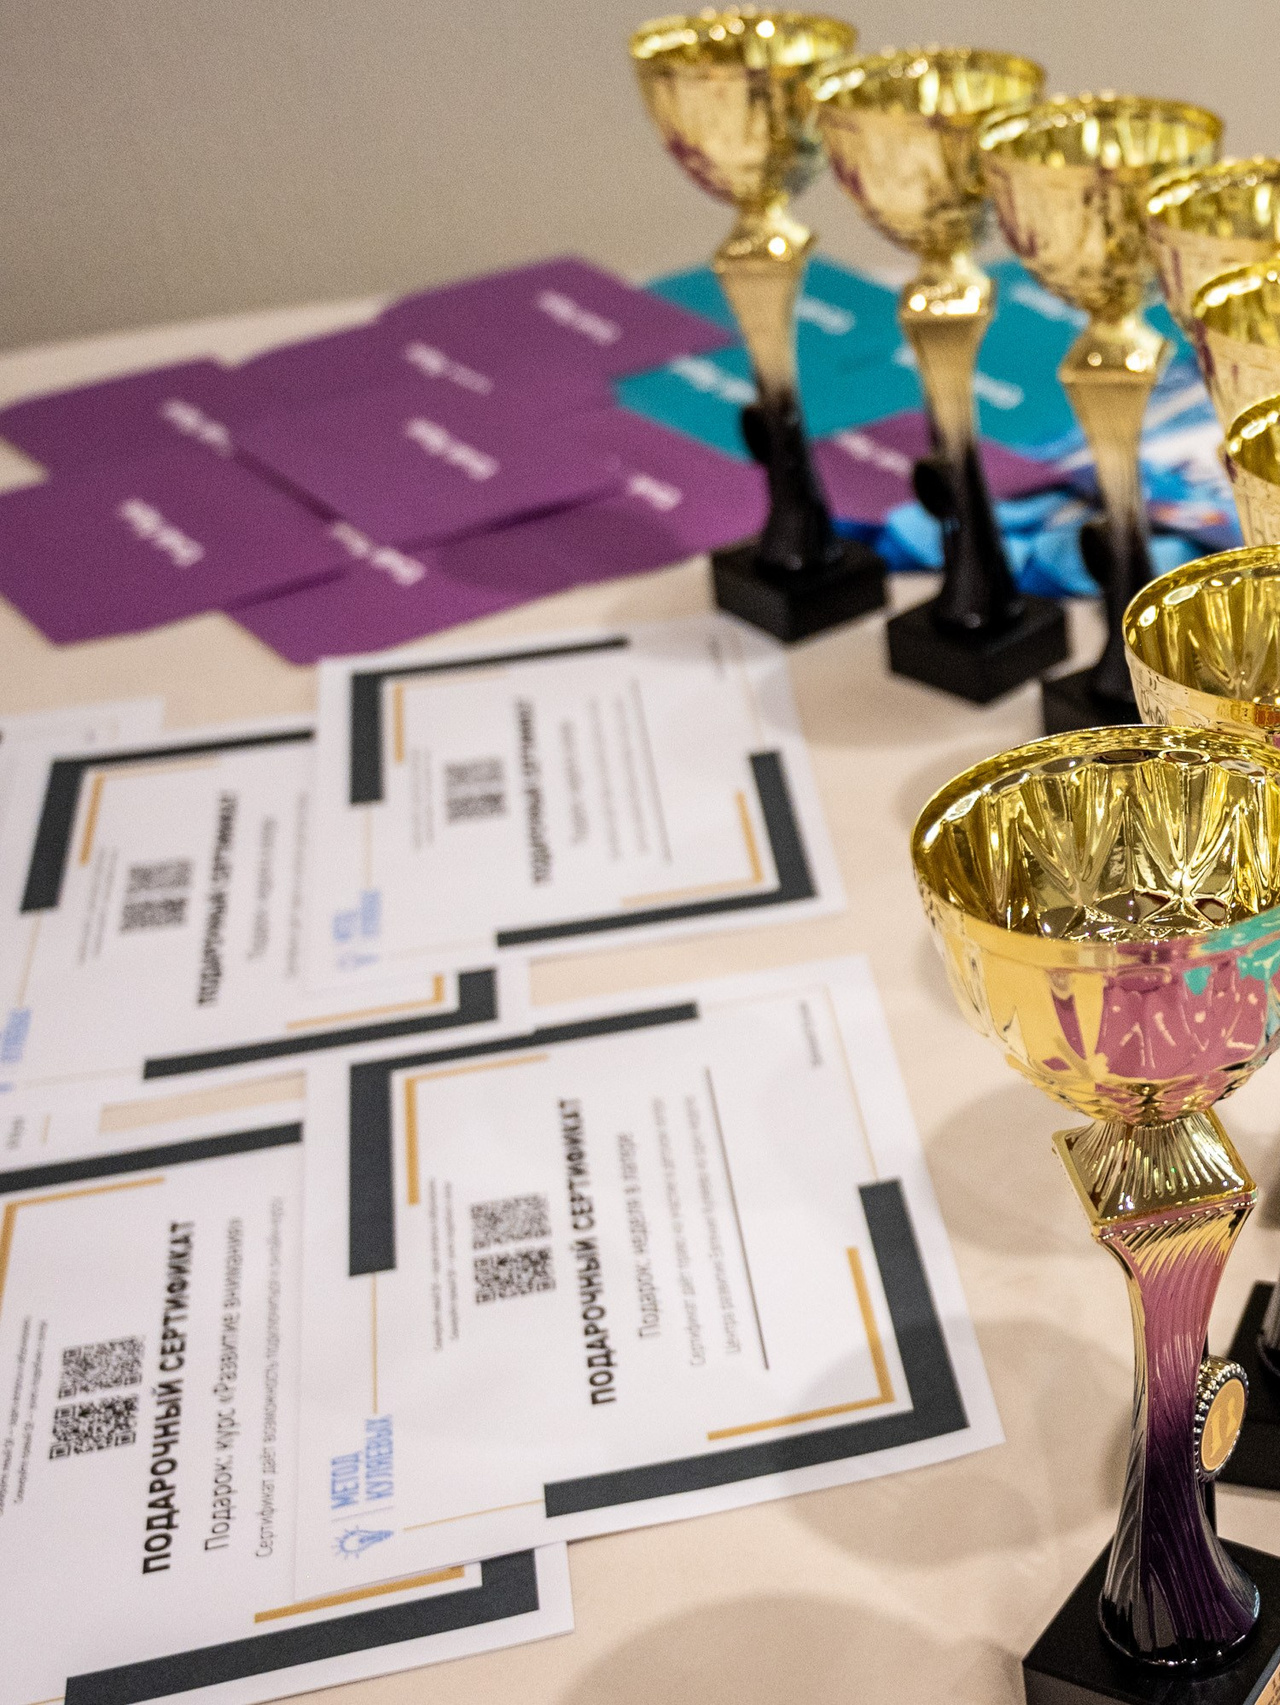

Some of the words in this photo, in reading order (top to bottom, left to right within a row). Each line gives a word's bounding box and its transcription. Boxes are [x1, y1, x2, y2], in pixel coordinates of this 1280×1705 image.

[558, 1097, 592, 1231] СЕРТИФИКАТ
[159, 1220, 195, 1371] СЕРТИФИКАТ
[568, 1238, 618, 1406] ПОДАРОЧНЫЙ
[142, 1378, 184, 1574] ПОДАРОЧНЫЙ
[214, 1408, 241, 1450] курс
[364, 1414, 394, 1501] КУЛЯЕВЫХ
[204, 1455, 237, 1551] Подарок:
[255, 1478, 278, 1558] Сертификат
[330, 1450, 362, 1511] МЕТОД
